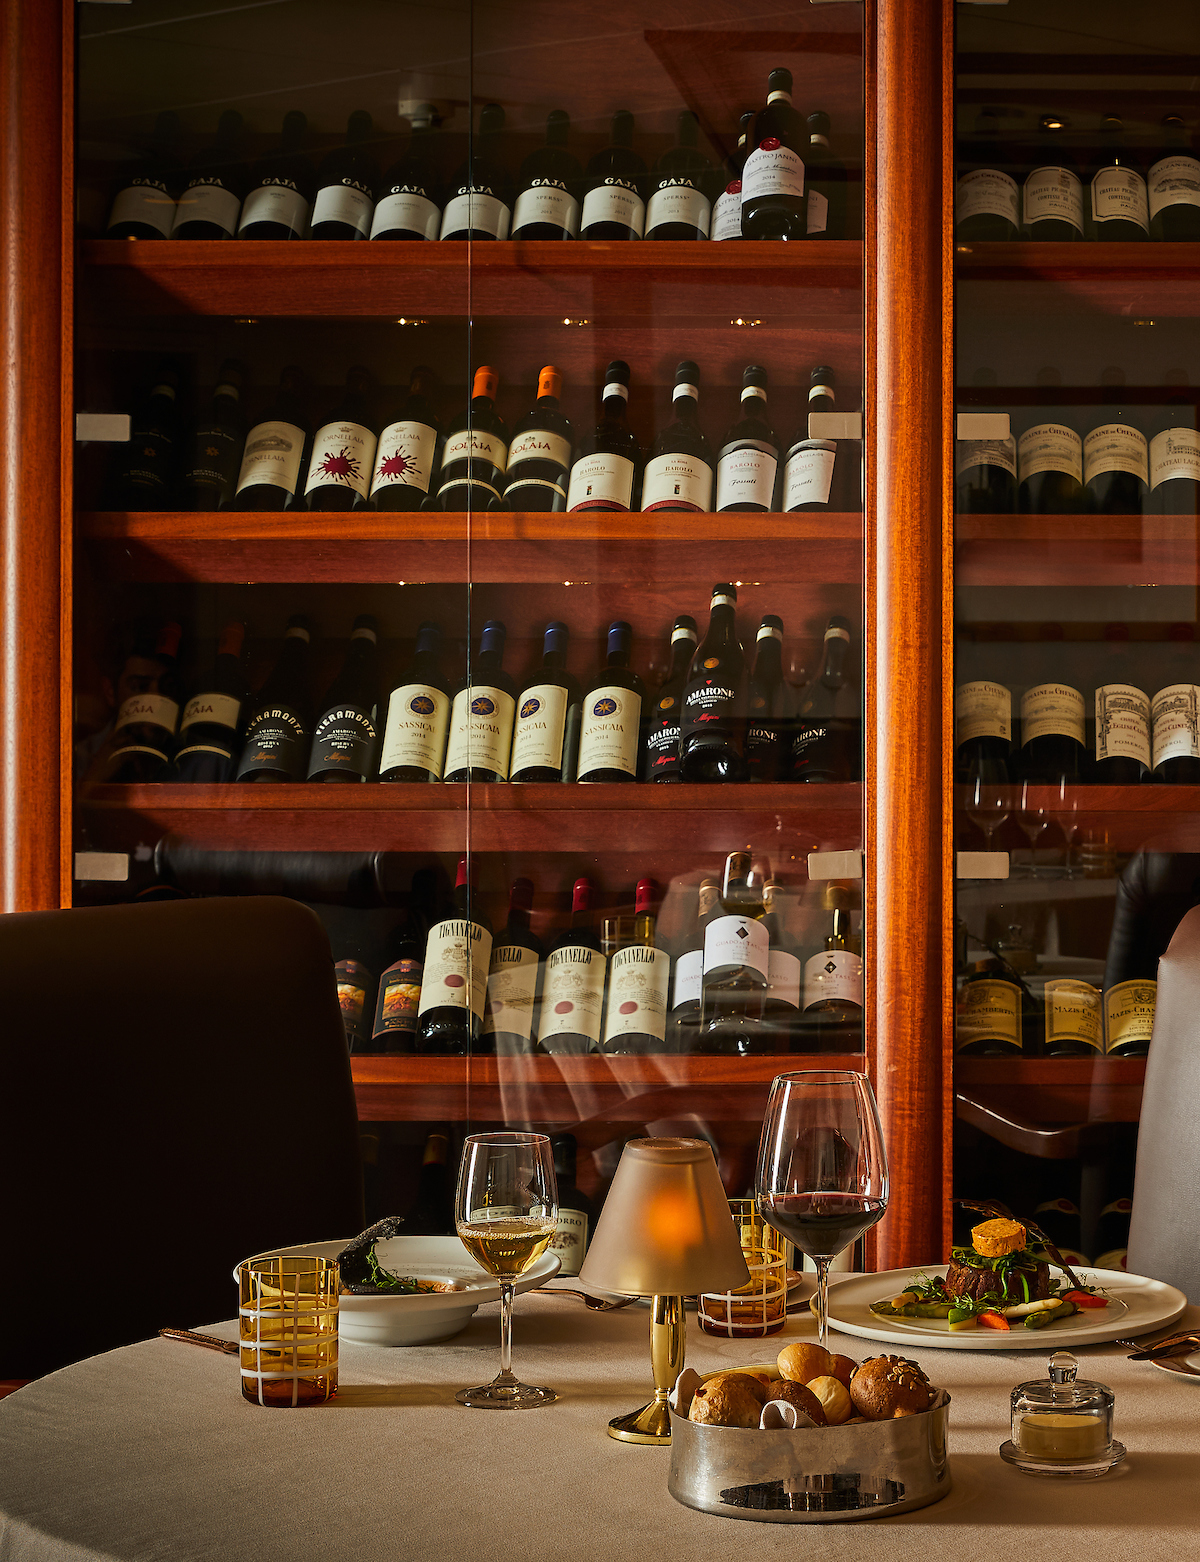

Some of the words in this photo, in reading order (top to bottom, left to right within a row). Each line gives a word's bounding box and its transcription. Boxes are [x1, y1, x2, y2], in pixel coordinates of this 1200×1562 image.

[132, 178, 167, 191] GAJA
[189, 177, 223, 188] GAJA
[261, 177, 298, 190] GAJA
[341, 177, 373, 197] GAJA
[531, 177, 567, 190] GAJA
[604, 176, 640, 194] GAJA
[658, 177, 695, 189] GAJA
[390, 184, 427, 196] GAJA
[457, 185, 494, 196] GAJA
[323, 433, 365, 446] ORNELLAIA
[450, 441, 492, 453] SOLAIA
[511, 442, 551, 457] SOLAIA
[730, 462, 761, 470] BAROLO
[686, 686, 736, 706] AMARONE
[459, 723, 500, 735] SASSICAIA
[584, 723, 624, 736] SASSICAIA
[749, 728, 779, 743] RONE
[647, 726, 682, 748] AMARON
[439, 922, 482, 942] TIGNANELLO
[550, 949, 592, 969] TIGNANELLO
[614, 948, 655, 969] TIGNANELLO
